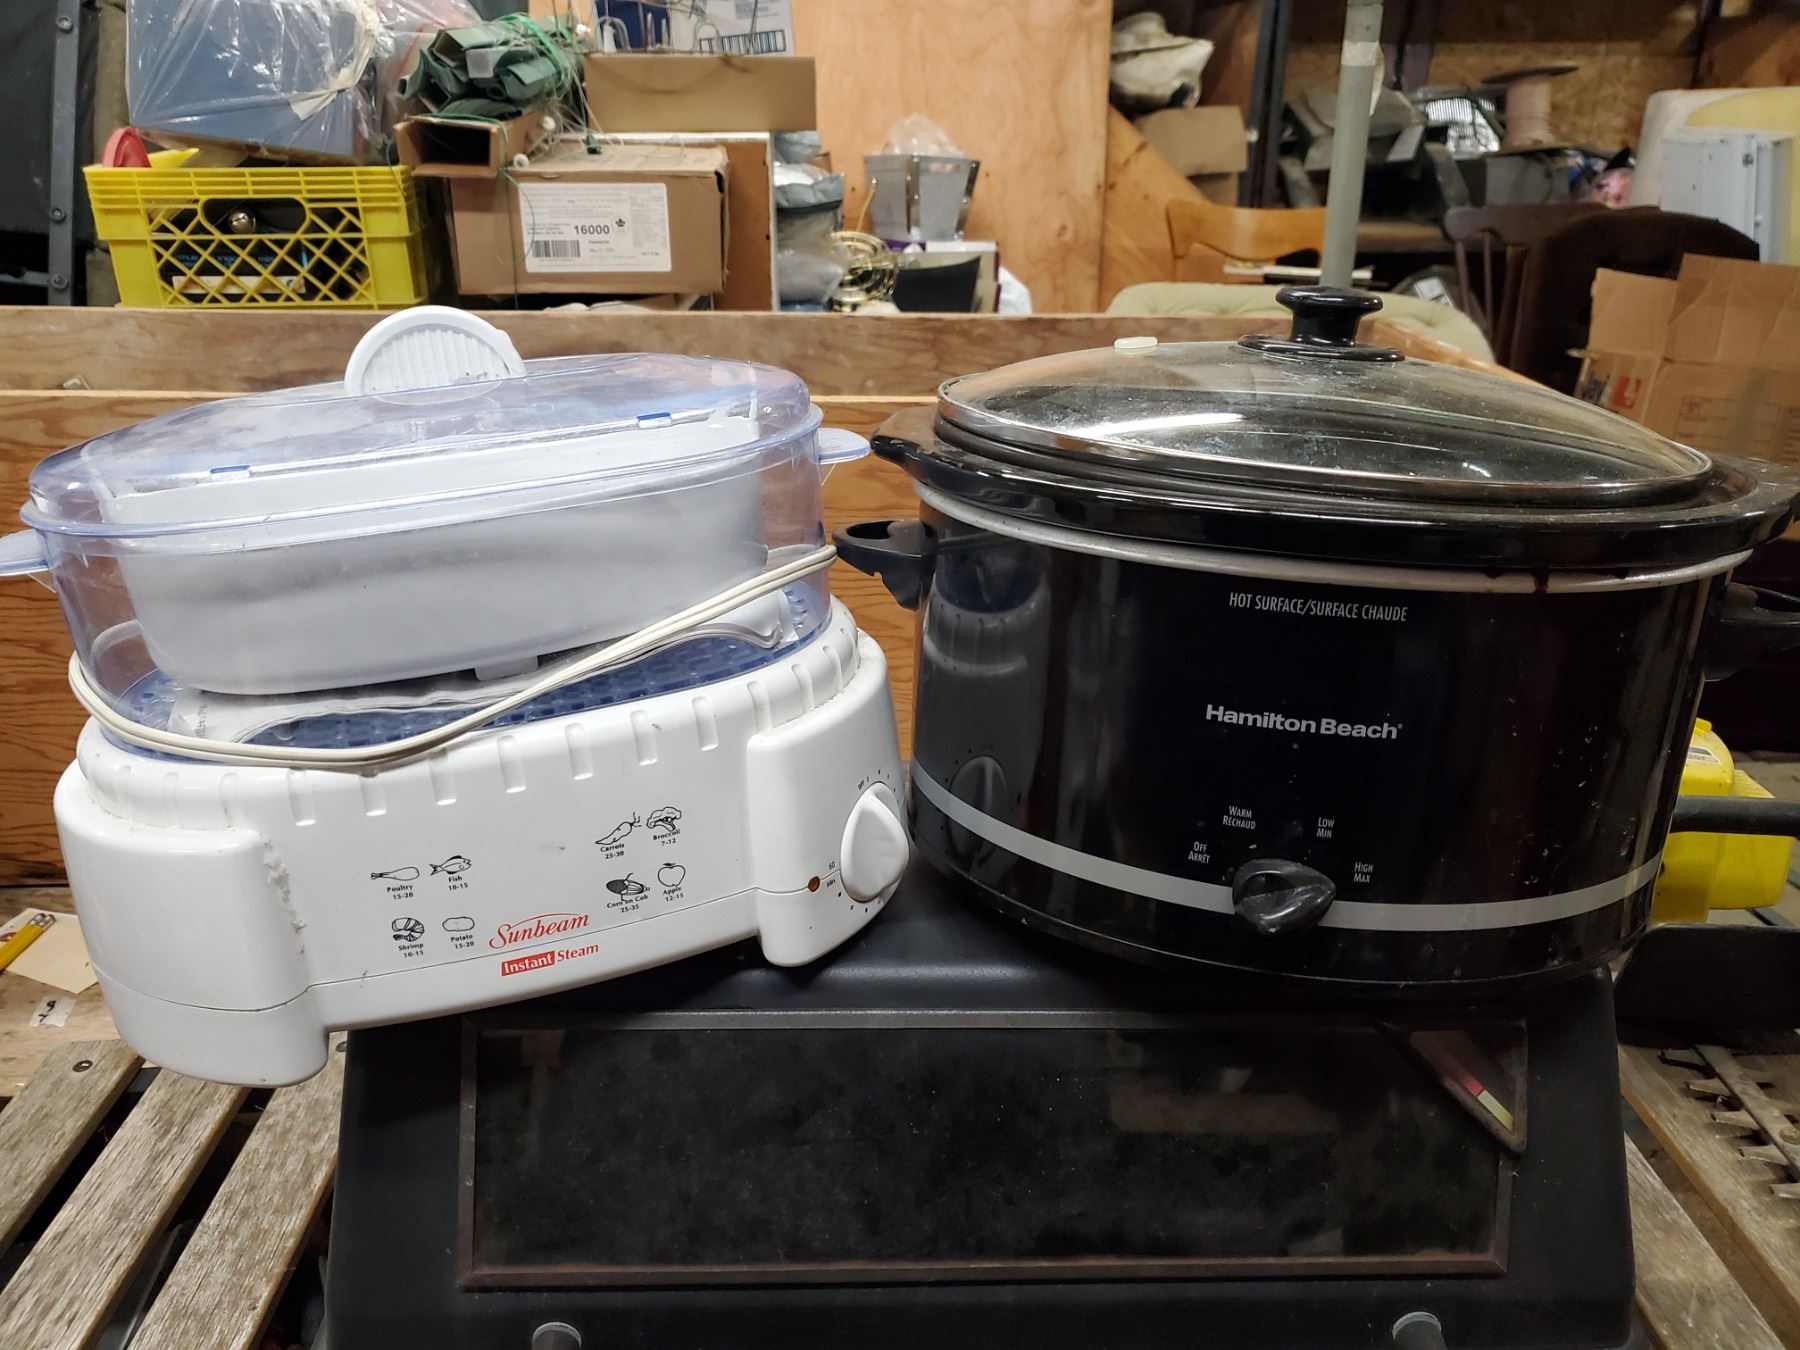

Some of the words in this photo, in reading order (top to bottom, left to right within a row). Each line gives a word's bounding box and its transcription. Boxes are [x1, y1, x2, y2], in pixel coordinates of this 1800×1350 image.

[573, 224, 611, 236] 16000
[1229, 591, 1253, 609] HOT
[1254, 594, 1359, 619] SURFACE/SURFACE
[1361, 604, 1409, 622] CHAUDE
[1205, 703, 1317, 734] Hamilton
[653, 829, 680, 840] Broccoli
[661, 837, 677, 846] 7-12
[600, 843, 625, 853] Carrots
[605, 850, 625, 860] 25-30
[448, 875, 463, 883] Fish
[386, 884, 414, 893] Poultry
[448, 882, 469, 891] 10-15
[662, 886, 682, 896] Apple
[393, 892, 414, 900] 15-20
[606, 900, 624, 909] Corn
[635, 894, 649, 902] Cob
[488, 913, 590, 950] Sunbeam
[450, 934, 474, 942] Potato
[398, 943, 425, 951] Shrimp
[454, 941, 475, 949] 15-20
[403, 950, 425, 958] 10-15
[503, 952, 554, 974] Instant
[557, 944, 600, 962] Steam
